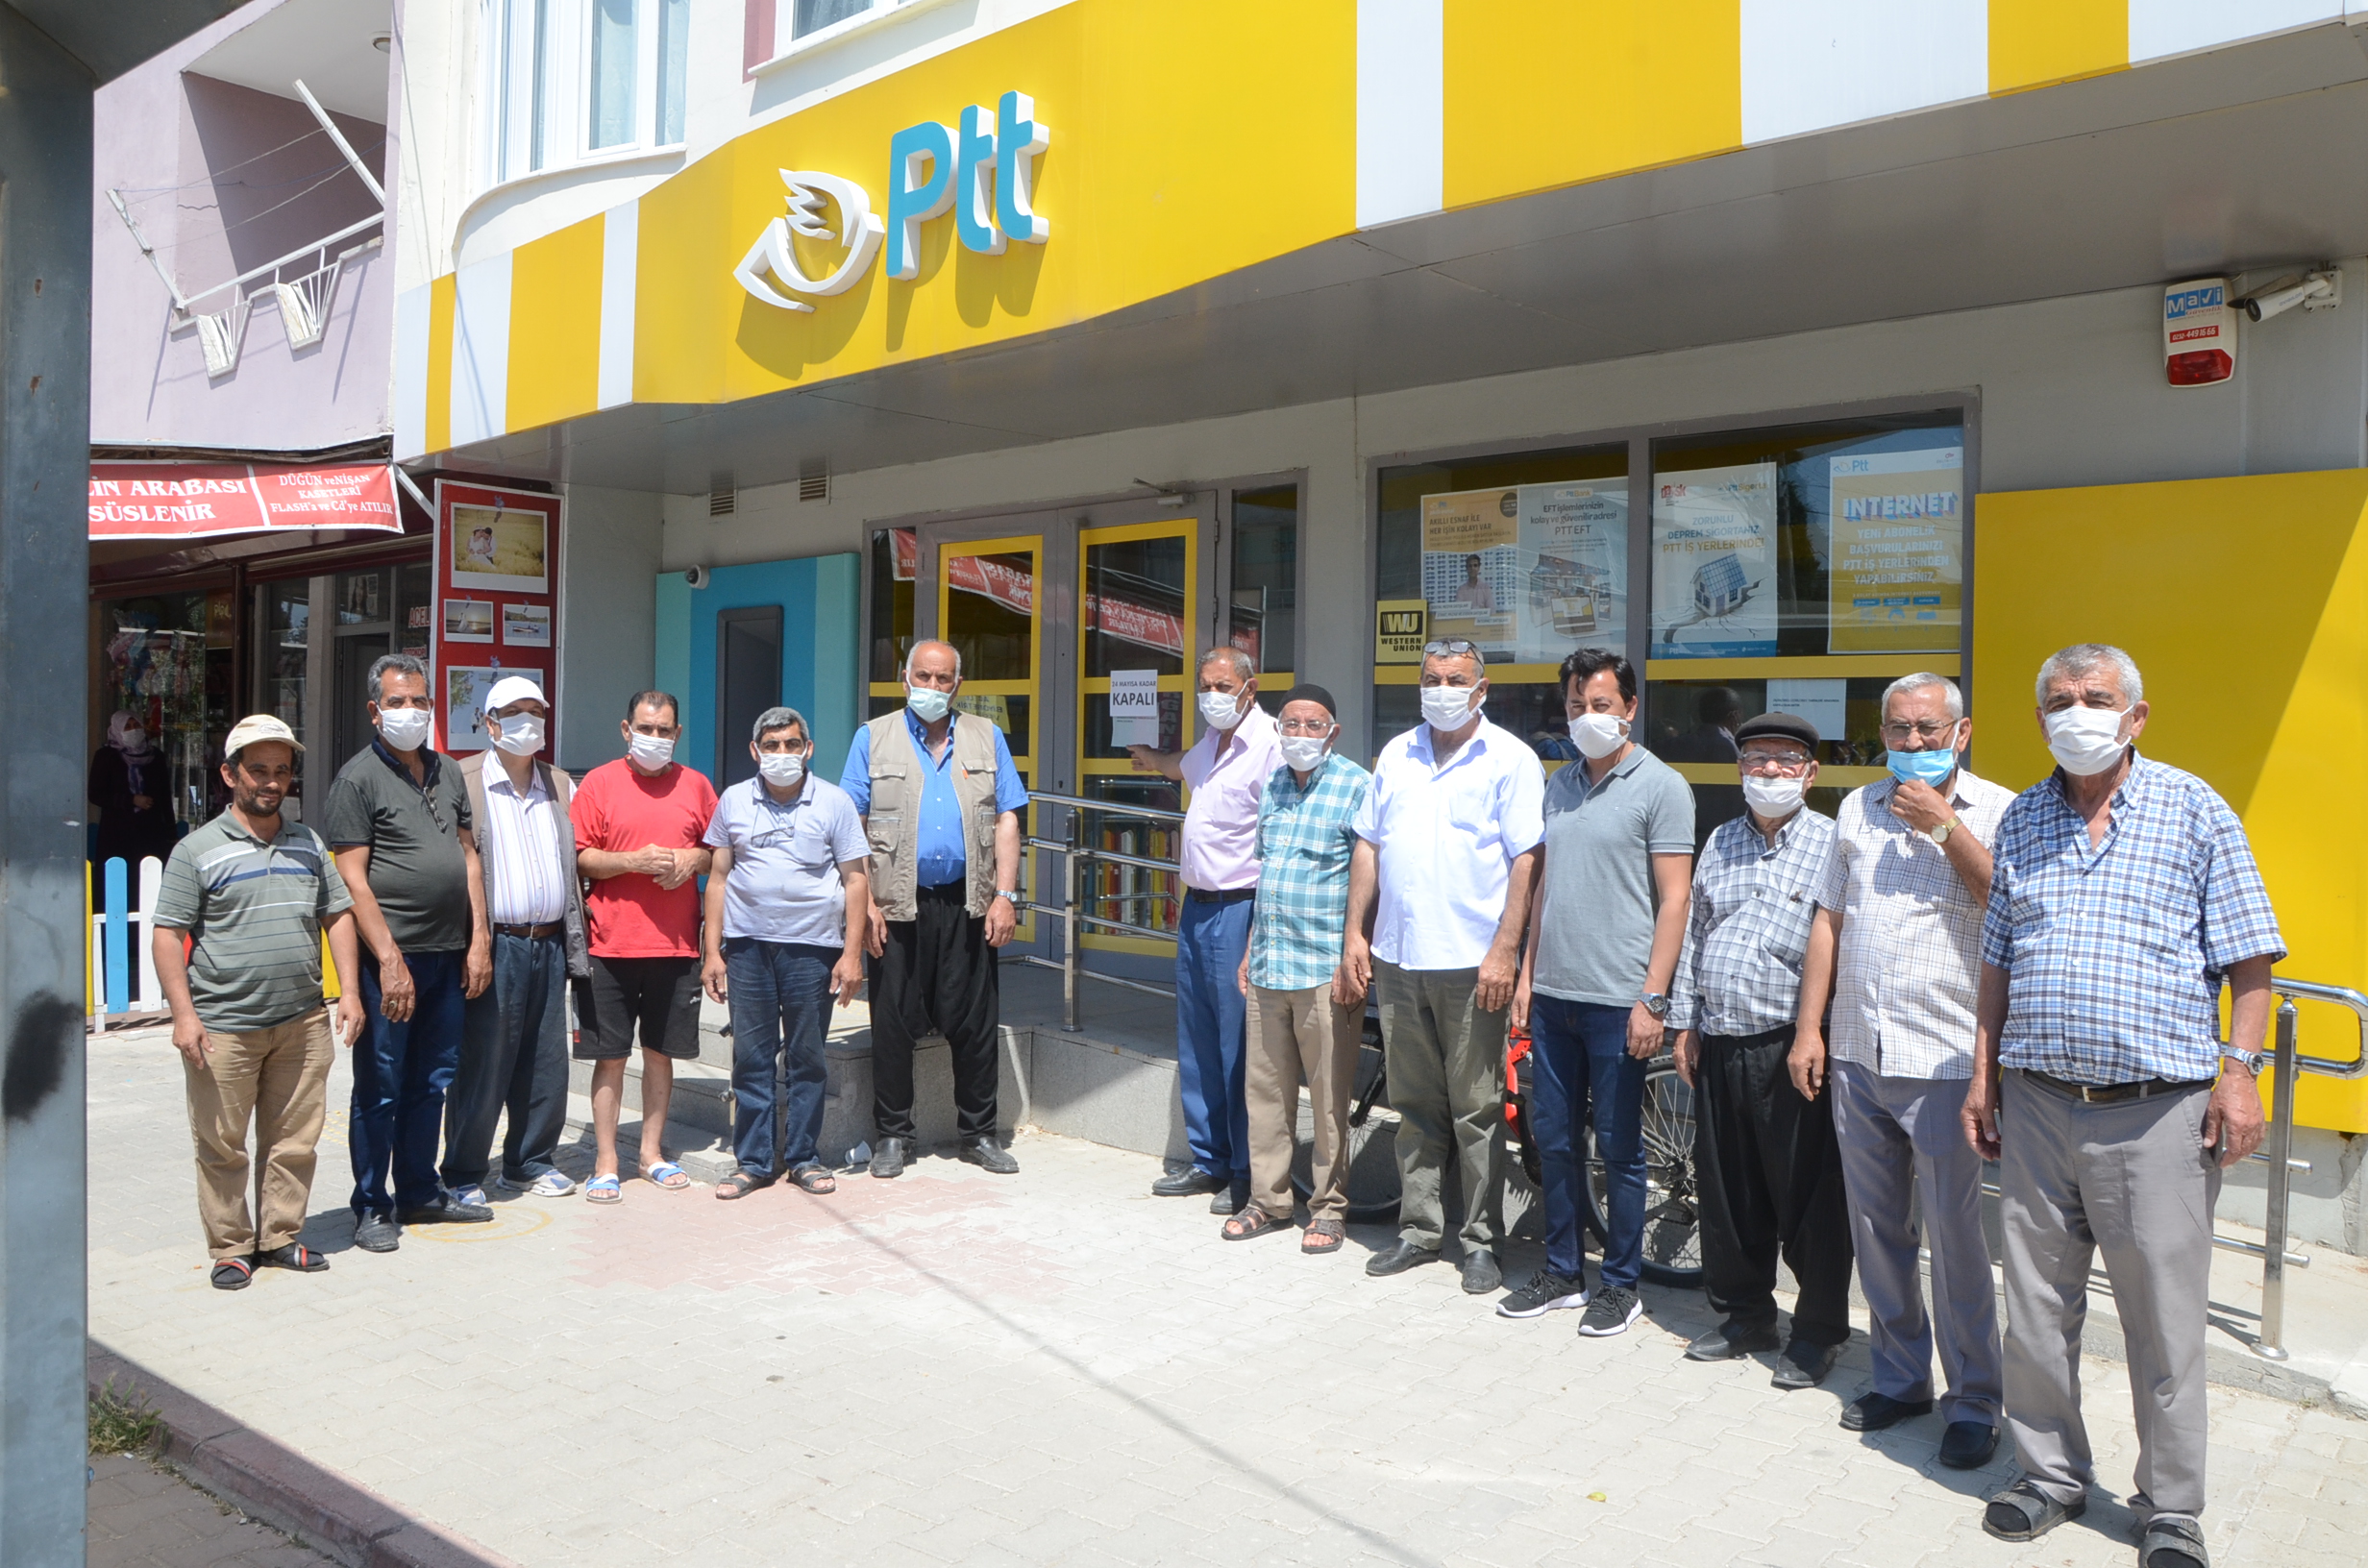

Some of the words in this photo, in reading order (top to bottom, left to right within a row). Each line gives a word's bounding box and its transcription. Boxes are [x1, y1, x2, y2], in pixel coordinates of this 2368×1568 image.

[886, 89, 1049, 281] Ptt
[1852, 459, 1869, 472] Ptt
[279, 472, 323, 486] DÜĞÜN
[131, 479, 248, 497] ARABASI
[298, 486, 362, 500] KASETLERİ
[88, 499, 217, 523] SÜSLENİR
[359, 502, 394, 515] ATILIR
[1542, 504, 1557, 513] EFT
[1557, 502, 1604, 514] işlemlerinizin
[1429, 517, 1449, 526] AKILLI
[1449, 515, 1469, 524] ESNAF
[1470, 513, 1481, 522] İLE
[1530, 516, 1549, 525] kolay
[1560, 512, 1593, 525] güvenilir
[1593, 510, 1617, 520] adresi
[1692, 515, 1734, 526] ZORUNLU
[1429, 527, 1442, 535] HER
[1456, 524, 1478, 532] KOLAYI
[1479, 523, 1492, 531] VAR
[1555, 526, 1573, 535] PTT
[1573, 525, 1591, 534] EFT
[1667, 529, 1702, 539] DEPREM
[1663, 543, 1682, 553] PTT
[1685, 540, 1694, 554] İŞ
[1843, 559, 1862, 570] PTT
[408, 606, 432, 628] ACEL
[1383, 613, 1418, 633] WU
[1112, 692, 1154, 706] KAPALI
